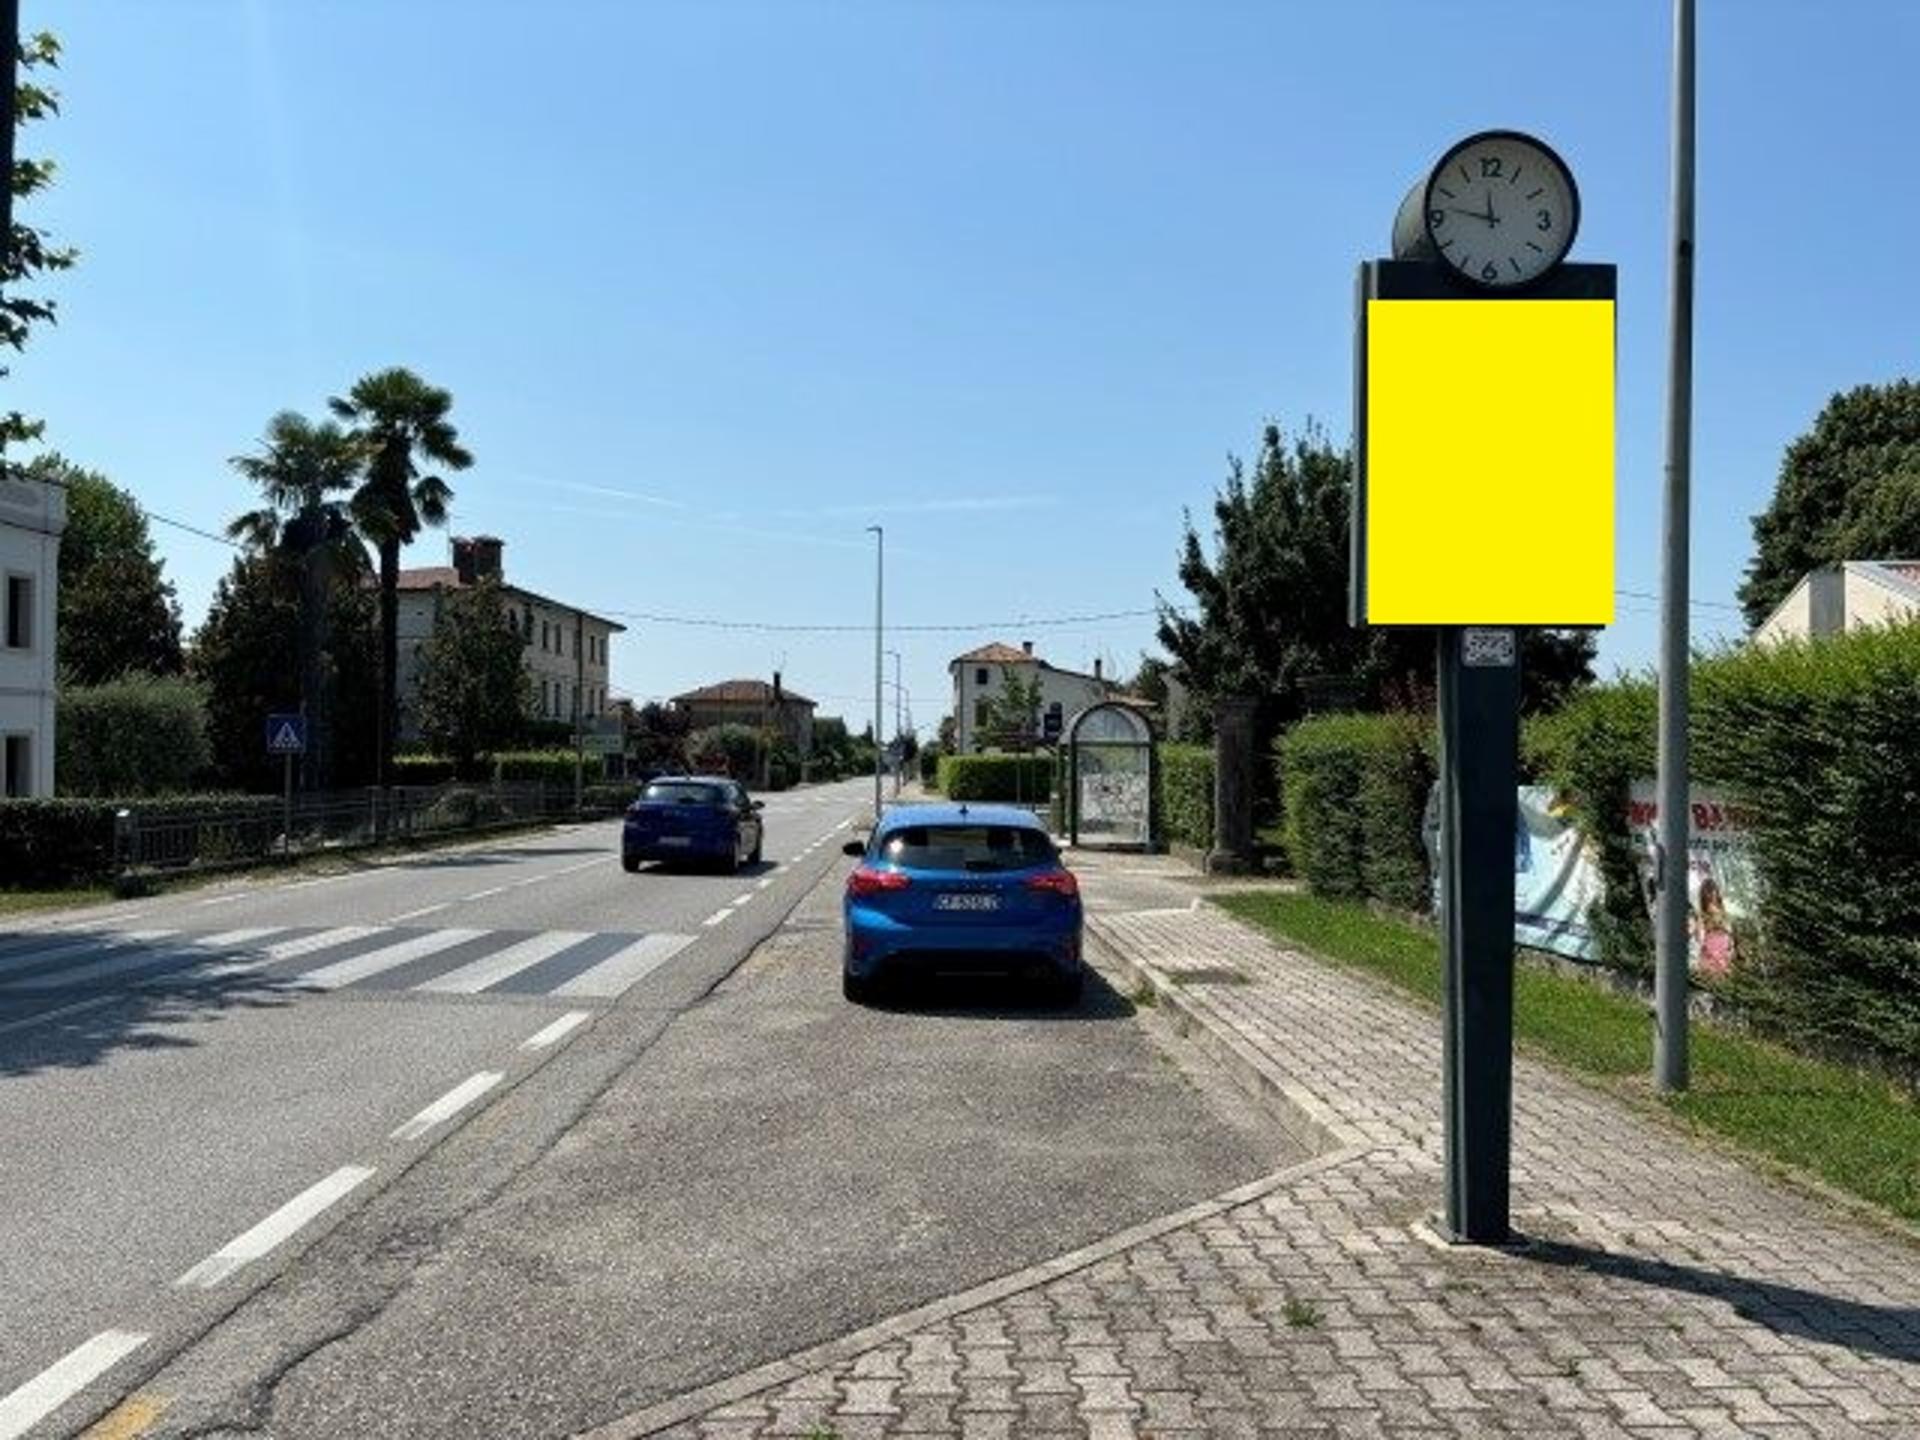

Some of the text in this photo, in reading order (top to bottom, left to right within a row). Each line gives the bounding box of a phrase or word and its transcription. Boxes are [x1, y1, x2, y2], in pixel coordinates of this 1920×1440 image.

[1480, 157, 1502, 178] 12
[1430, 209, 1444, 229] 9
[1537, 209, 1552, 231] 3
[1481, 260, 1498, 280] 6
